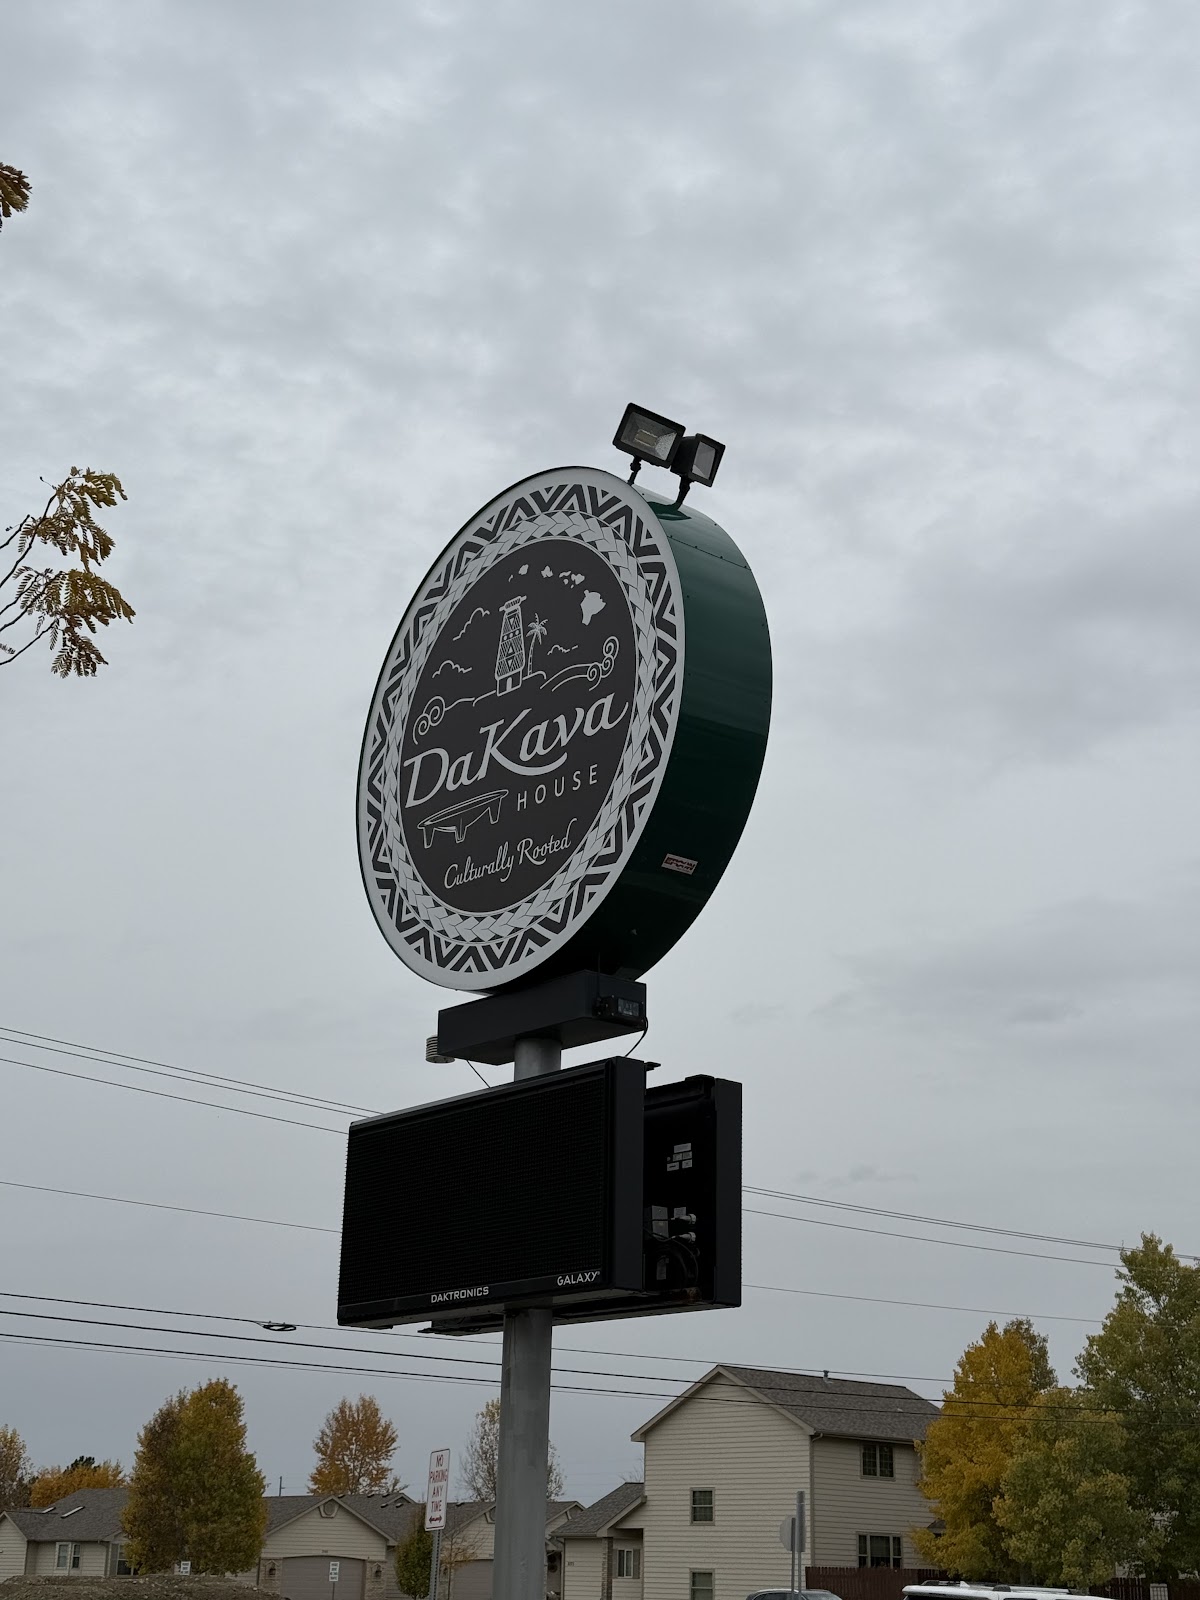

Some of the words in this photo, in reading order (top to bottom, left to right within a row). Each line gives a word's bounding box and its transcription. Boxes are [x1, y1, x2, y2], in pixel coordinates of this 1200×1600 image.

[517, 764, 598, 811] HOUSE
[444, 841, 514, 889] Culturally
[517, 818, 578, 866] Rooted
[556, 1271, 599, 1286] GALAXY
[430, 1286, 489, 1303] DAKTRONICS
[436, 1454, 444, 1467] NO
[430, 1469, 448, 1483] PARKING
[432, 1486, 443, 1498] ANY
[431, 1500, 442, 1512] TIME
